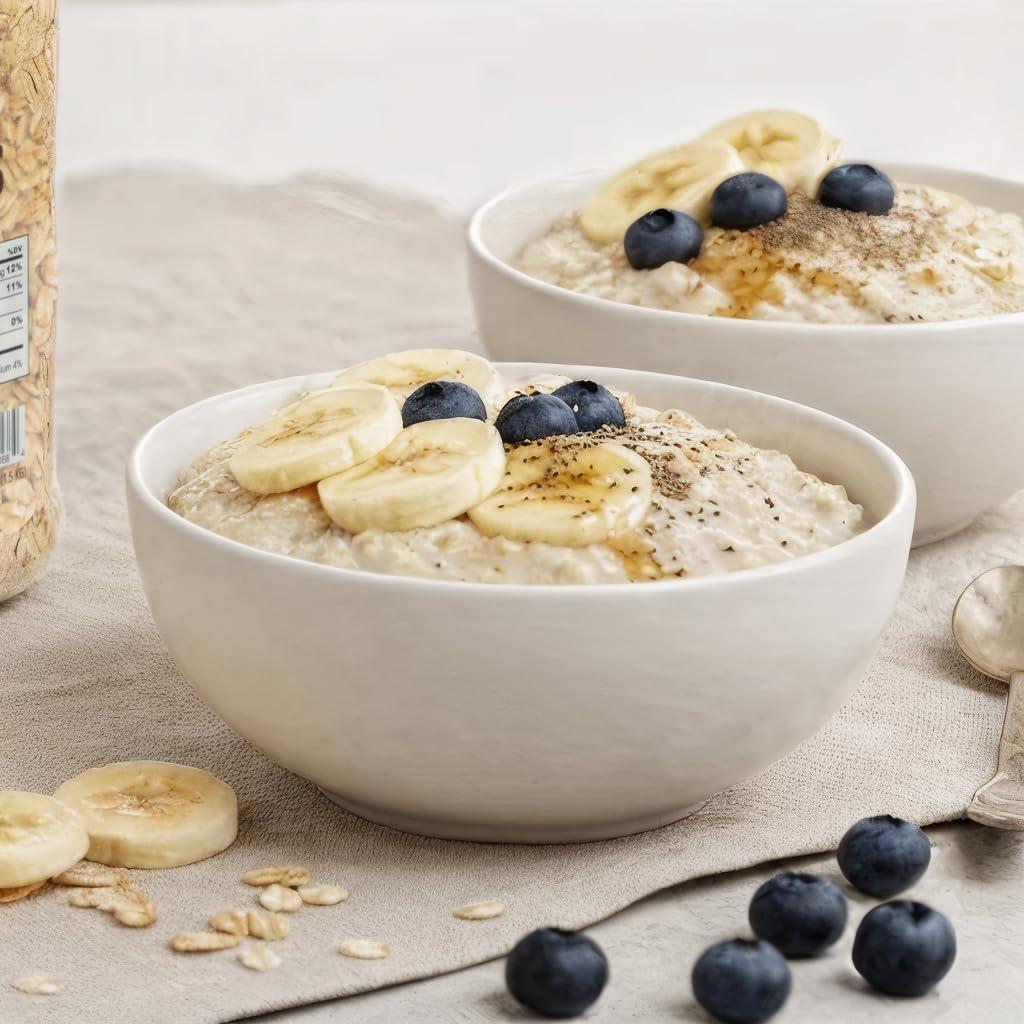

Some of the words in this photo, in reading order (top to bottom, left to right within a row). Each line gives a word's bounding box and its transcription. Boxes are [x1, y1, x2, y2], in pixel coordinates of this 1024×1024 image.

[8, 246, 22, 255] %DV
[6, 263, 22, 274] 12%
[6, 282, 22, 292] 11%
[11, 316, 22, 325] 0%
[13, 360, 22, 369] 4%
